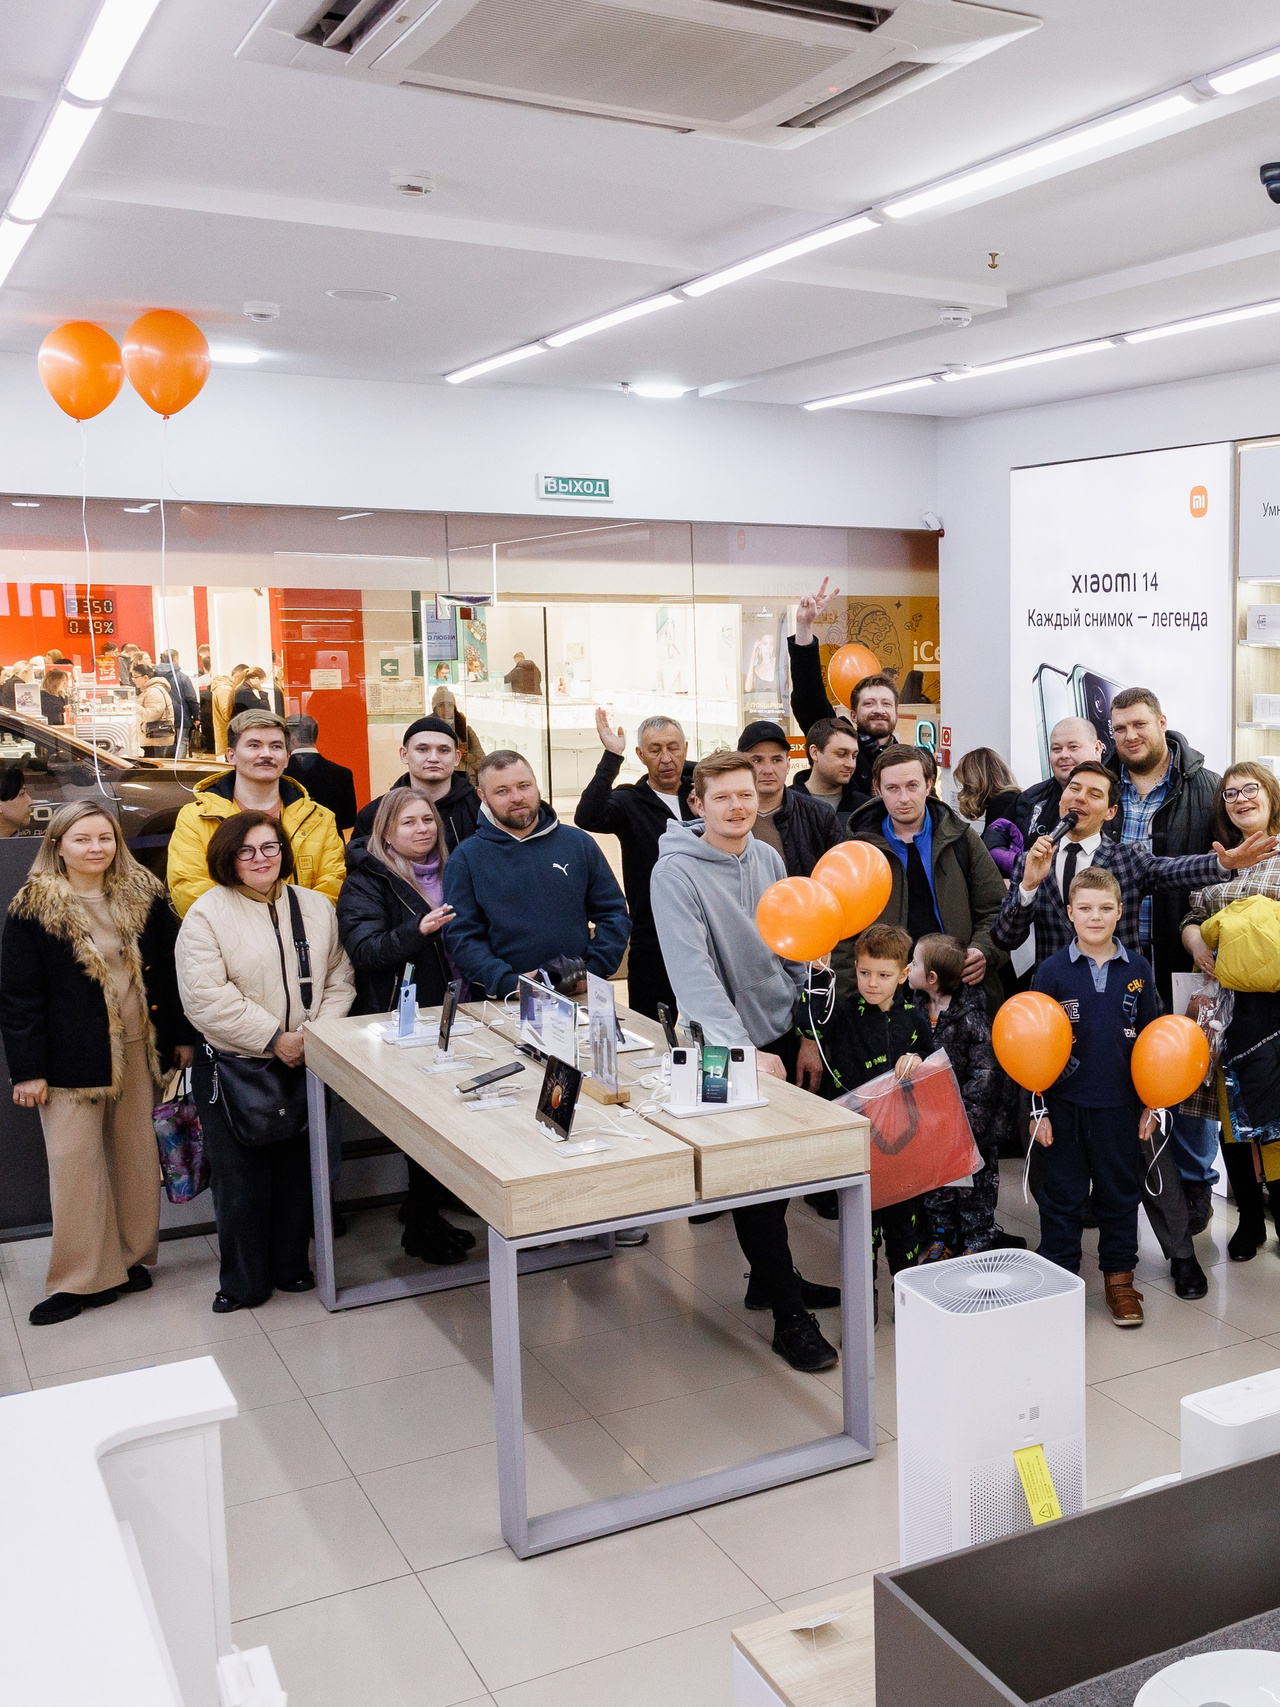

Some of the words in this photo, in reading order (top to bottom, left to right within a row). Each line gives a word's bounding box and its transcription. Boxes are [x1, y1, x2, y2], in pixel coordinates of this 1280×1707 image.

[547, 479, 606, 495] ВЫХОД
[1142, 571, 1159, 592] 14
[1027, 608, 1081, 630] Каждый
[1084, 612, 1134, 627] снимок
[1151, 611, 1208, 631] легенда
[707, 1065, 723, 1079] 13
